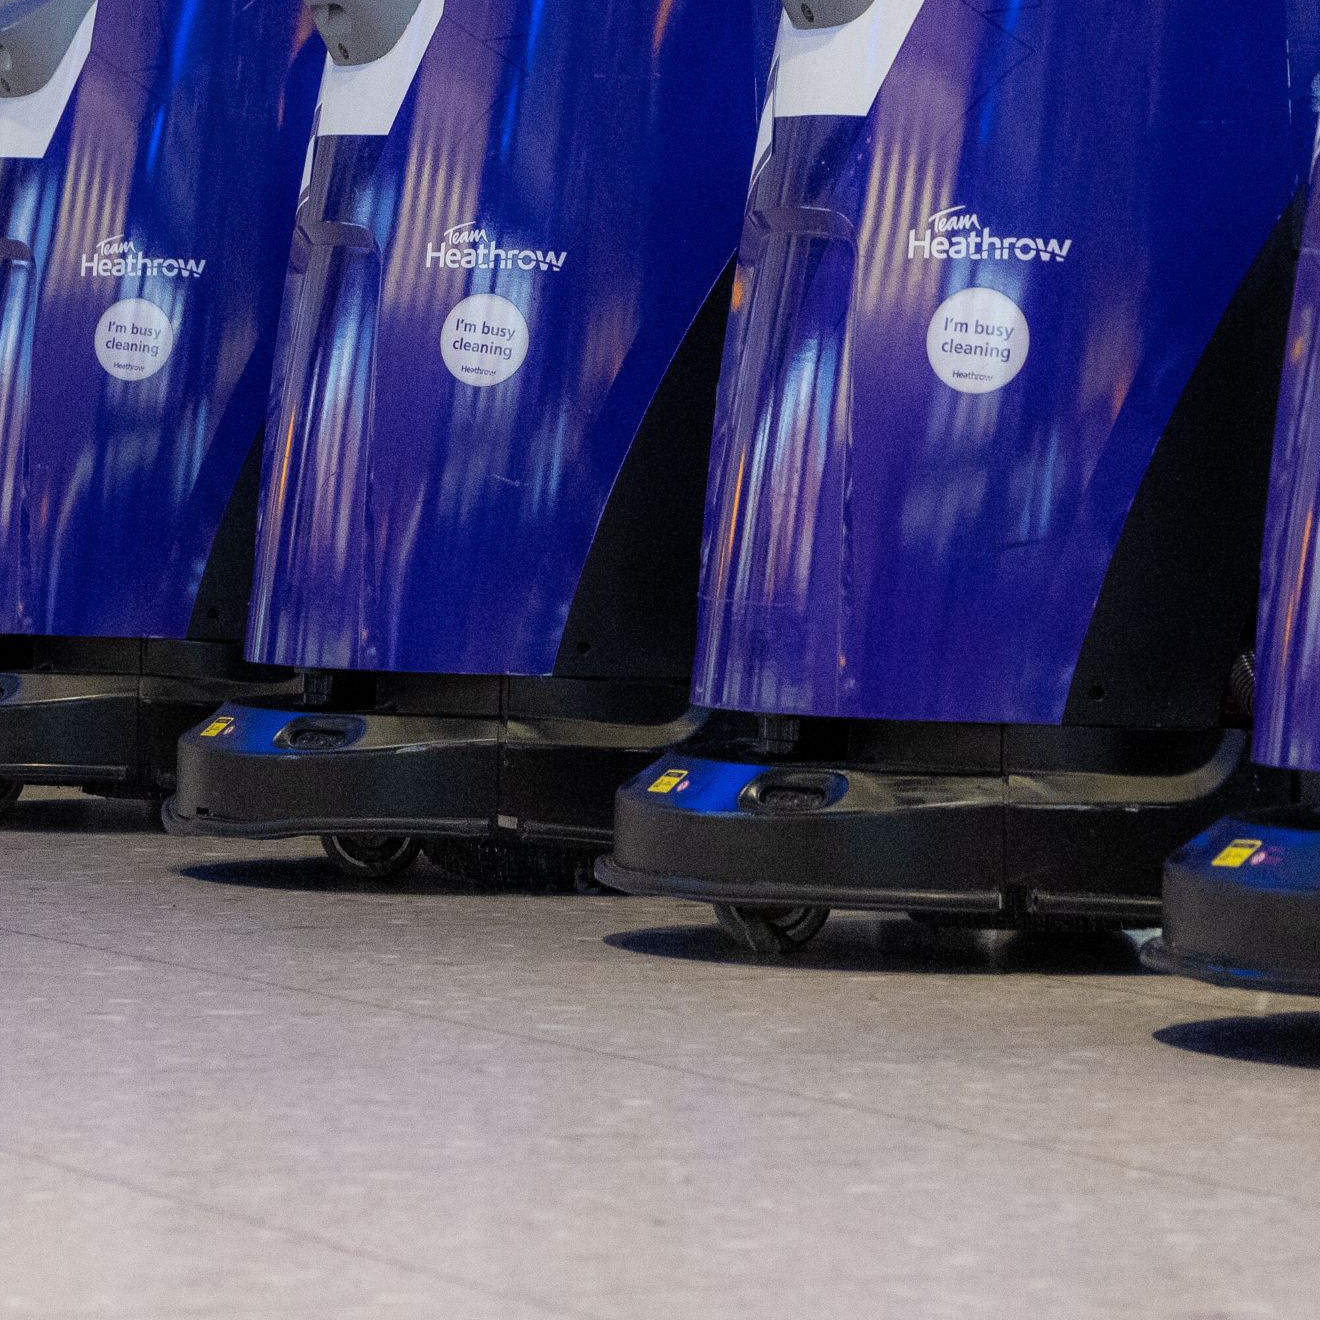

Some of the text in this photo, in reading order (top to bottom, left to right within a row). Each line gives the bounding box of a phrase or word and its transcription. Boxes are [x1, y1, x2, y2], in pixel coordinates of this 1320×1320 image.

[929, 205, 981, 232] Team
[96, 234, 137, 256] Team
[443, 221, 488, 245] Team
[908, 227, 1073, 262] Heathrow
[80, 251, 207, 278] Heathrow
[425, 241, 567, 272] Heathrow
[108, 321, 162, 340] I'm busy
[455, 318, 516, 341] I'm busy
[944, 317, 1014, 341] I'm busy
[105, 338, 159, 357] cleaning
[452, 337, 513, 360] cleaning
[941, 339, 1011, 363] cleaning
[461, 365, 496, 377] Heathrow
